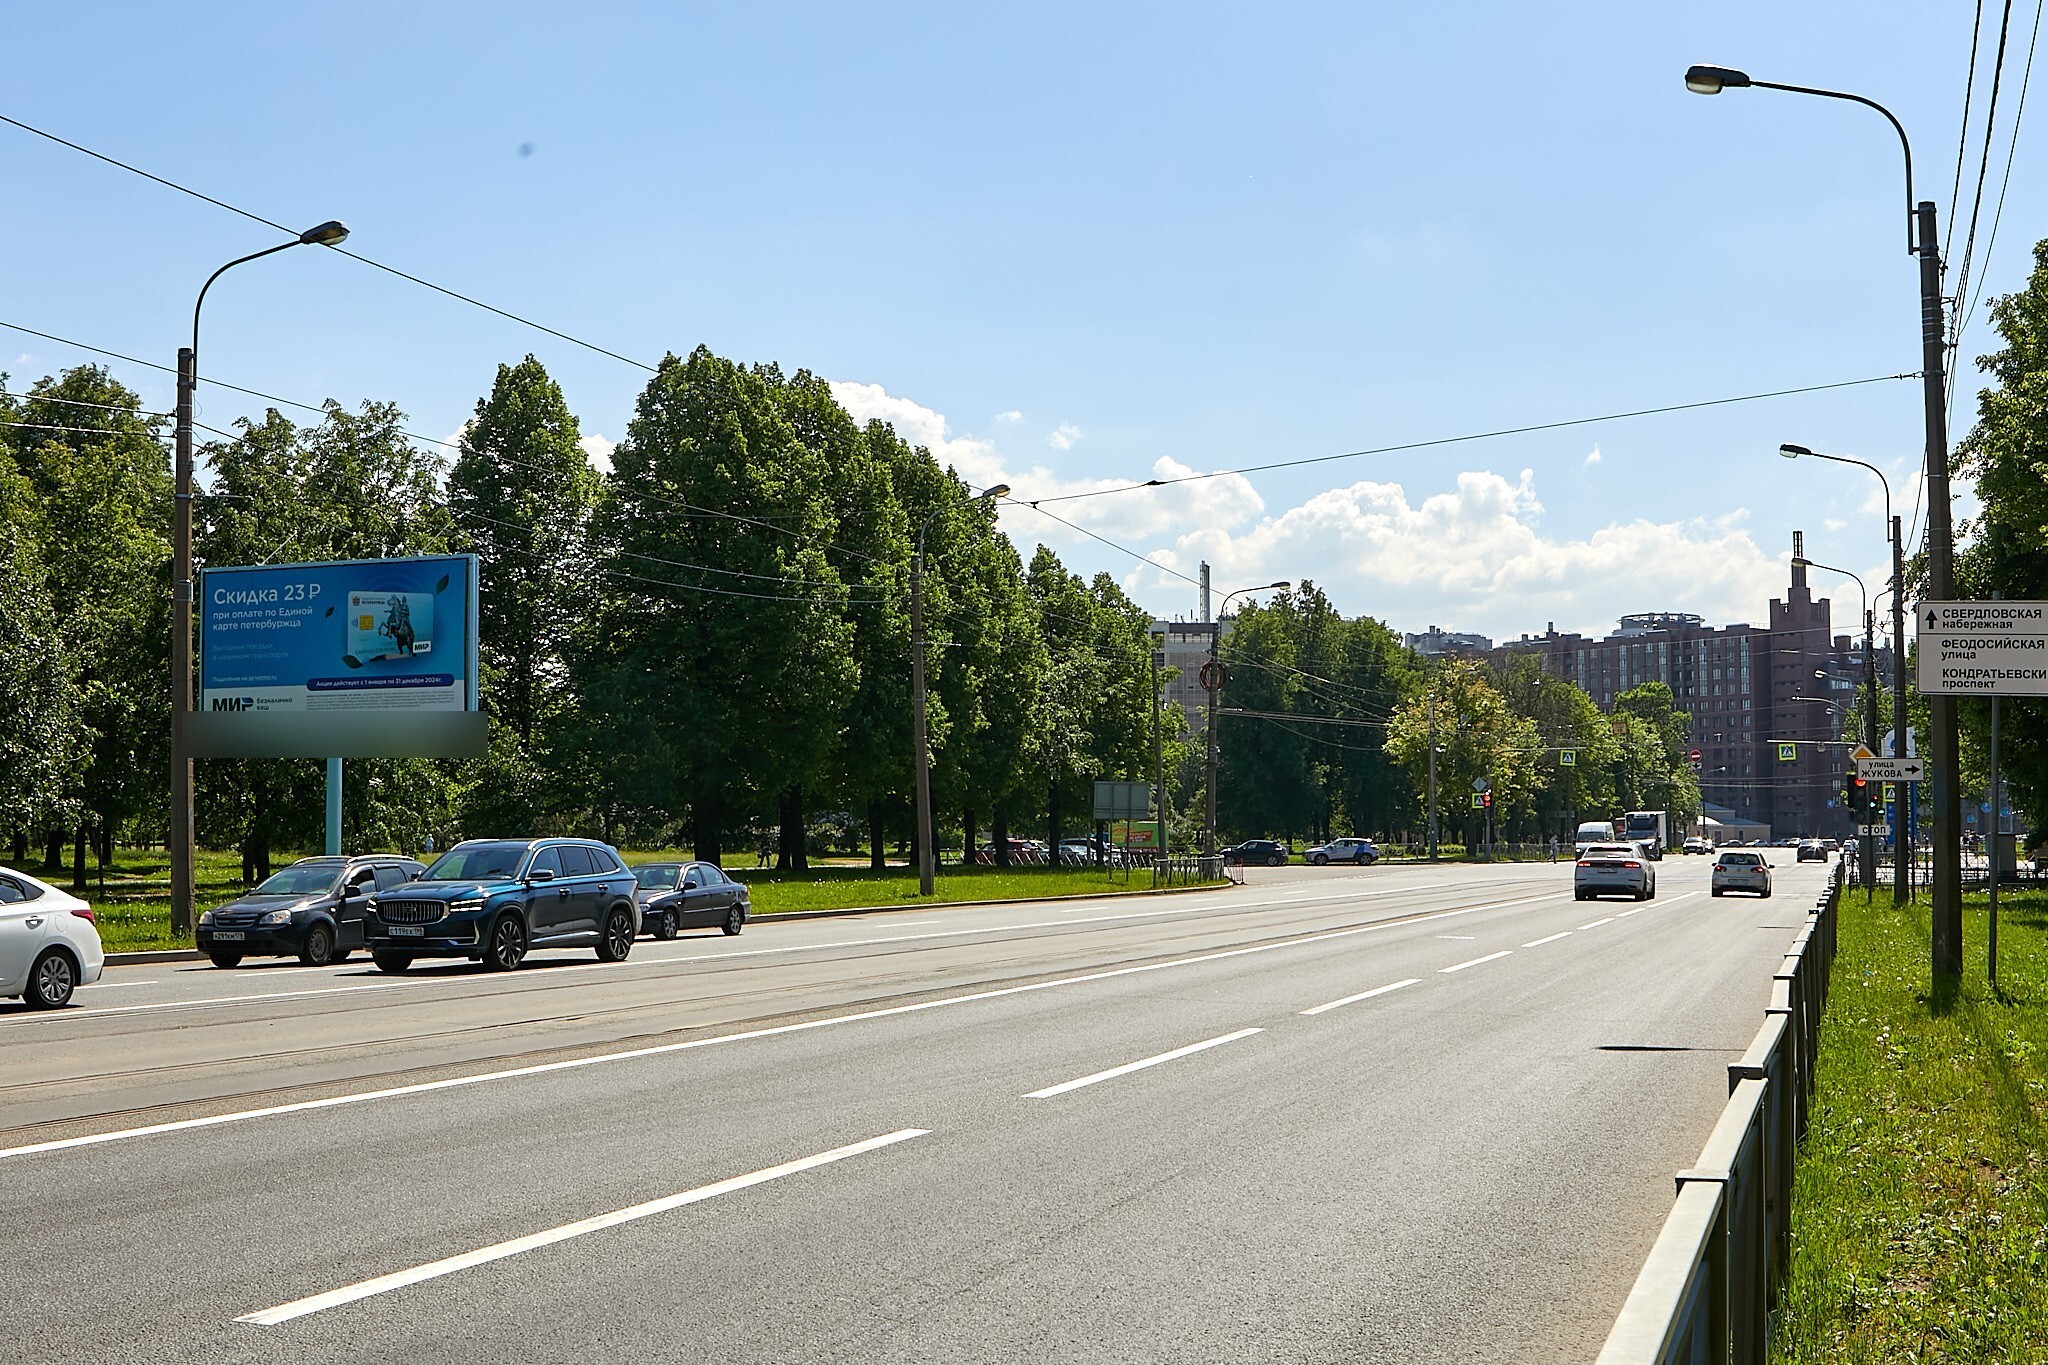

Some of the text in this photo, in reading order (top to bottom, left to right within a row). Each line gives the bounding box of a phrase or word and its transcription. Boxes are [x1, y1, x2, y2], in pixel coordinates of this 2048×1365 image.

[214, 588, 278, 606] Скидка
[213, 606, 313, 621] при оплате по Единой
[1942, 608, 2042, 620] СВЕРДЛОВСКАЯ
[213, 619, 301, 632] карте петербуржца
[1942, 619, 2013, 631] набережная
[1941, 637, 2045, 651] ФЕОДОСИЙСКАЯ
[1941, 651, 1976, 661] улица
[333, 679, 360, 687] действует
[402, 677, 424, 685] декабря
[1942, 680, 1996, 690] проспект
[212, 697, 254, 711] МИР
[1868, 761, 1895, 769] улица
[1861, 770, 1903, 778] ЖУКОВА
